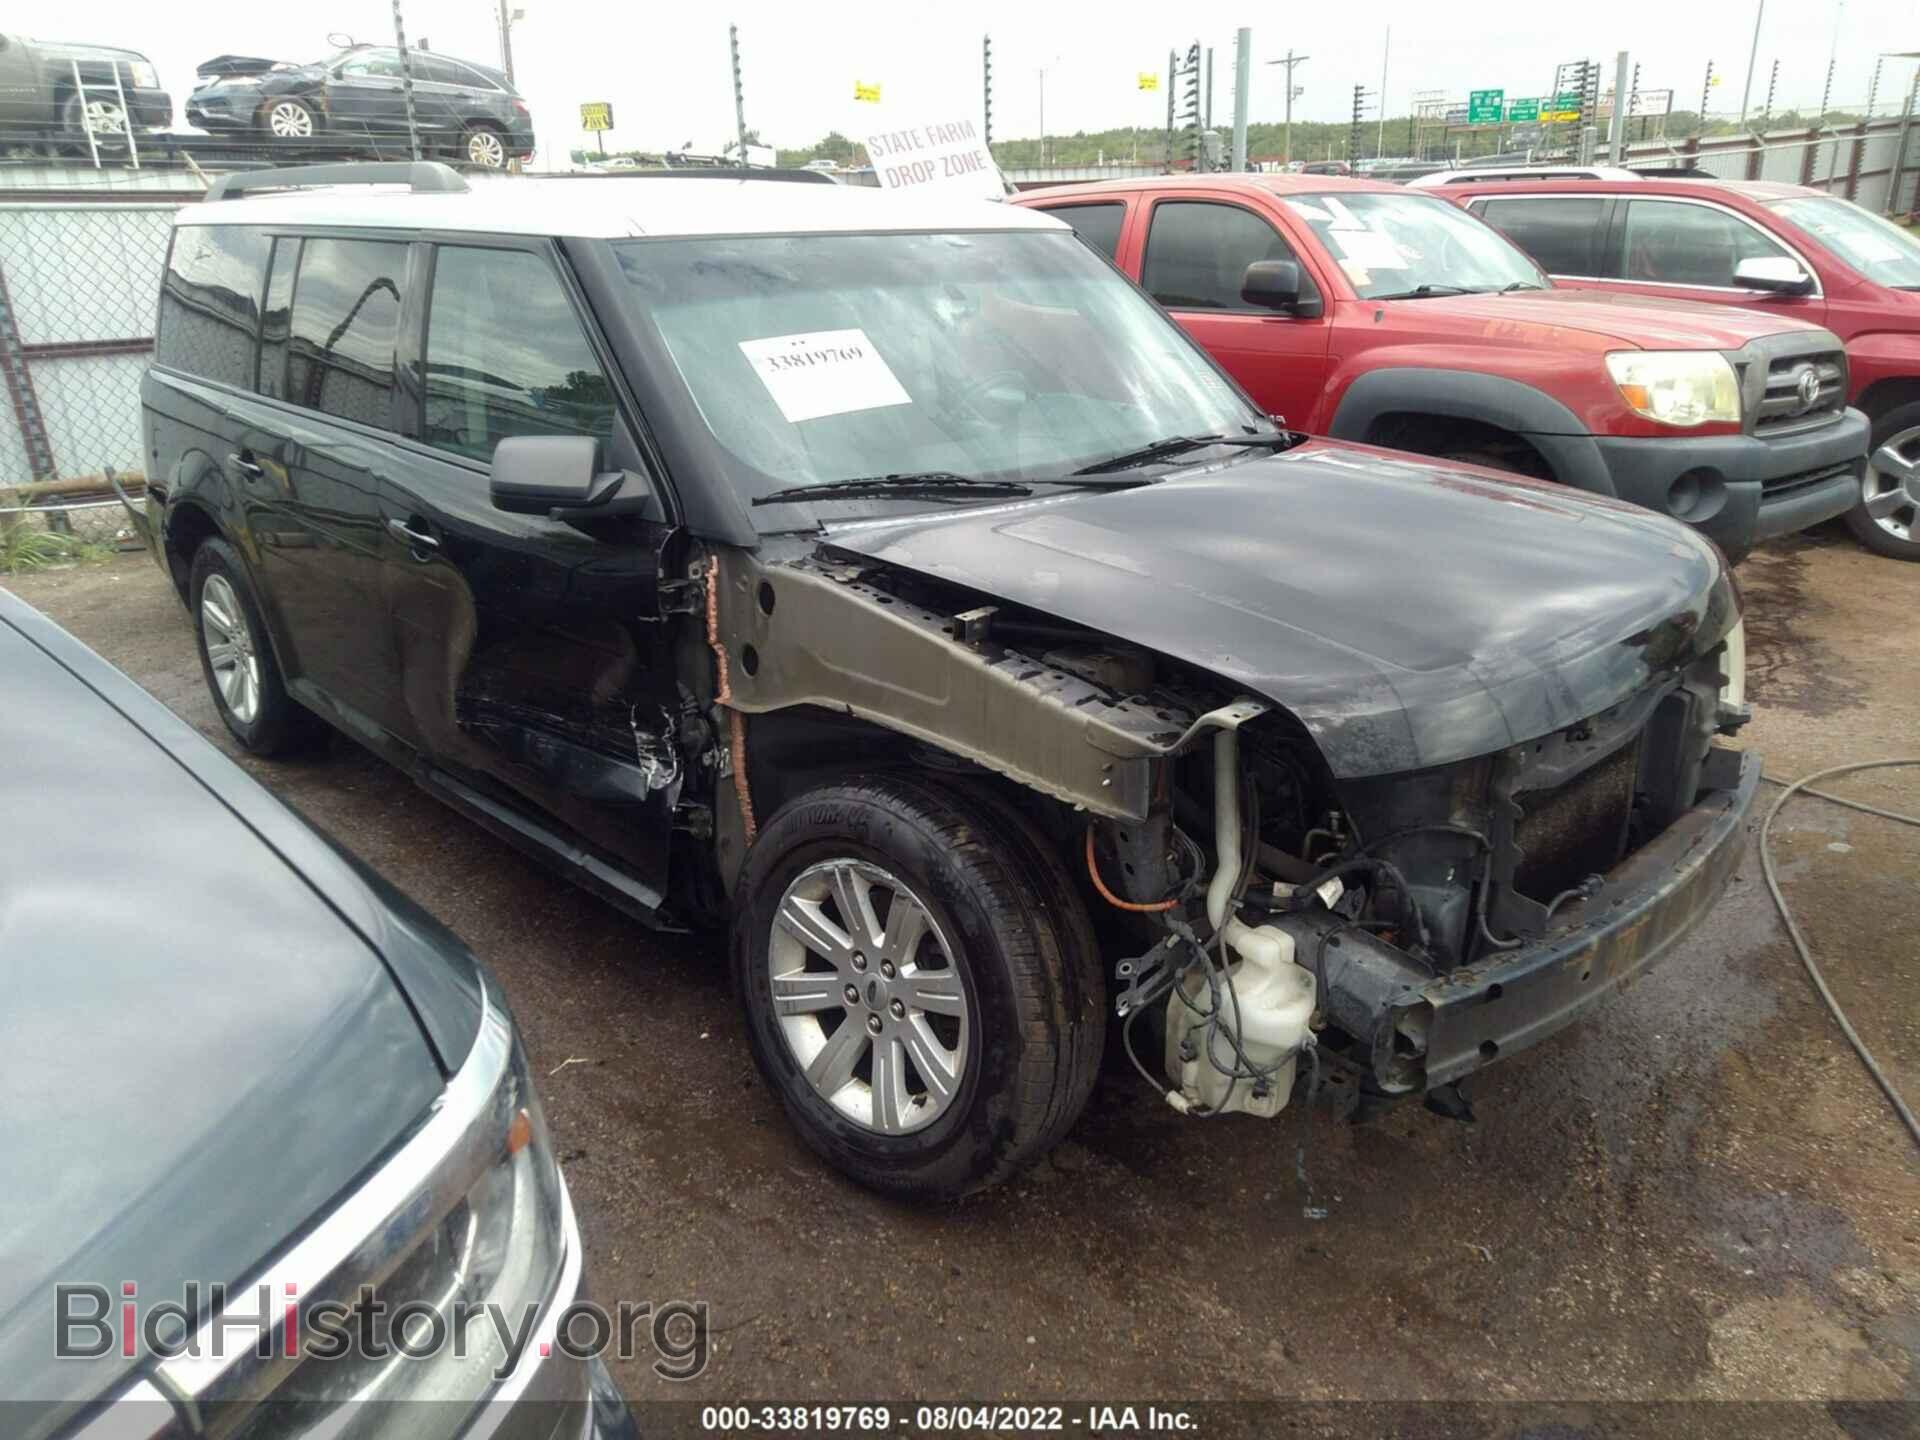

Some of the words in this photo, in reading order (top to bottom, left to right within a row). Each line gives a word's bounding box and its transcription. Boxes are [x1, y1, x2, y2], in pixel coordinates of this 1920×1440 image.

[868, 128, 924, 157] STATE
[926, 120, 976, 147] FARM
[885, 159, 935, 189] DROP
[939, 150, 987, 178] ZONE
[767, 346, 863, 372] 33819769
